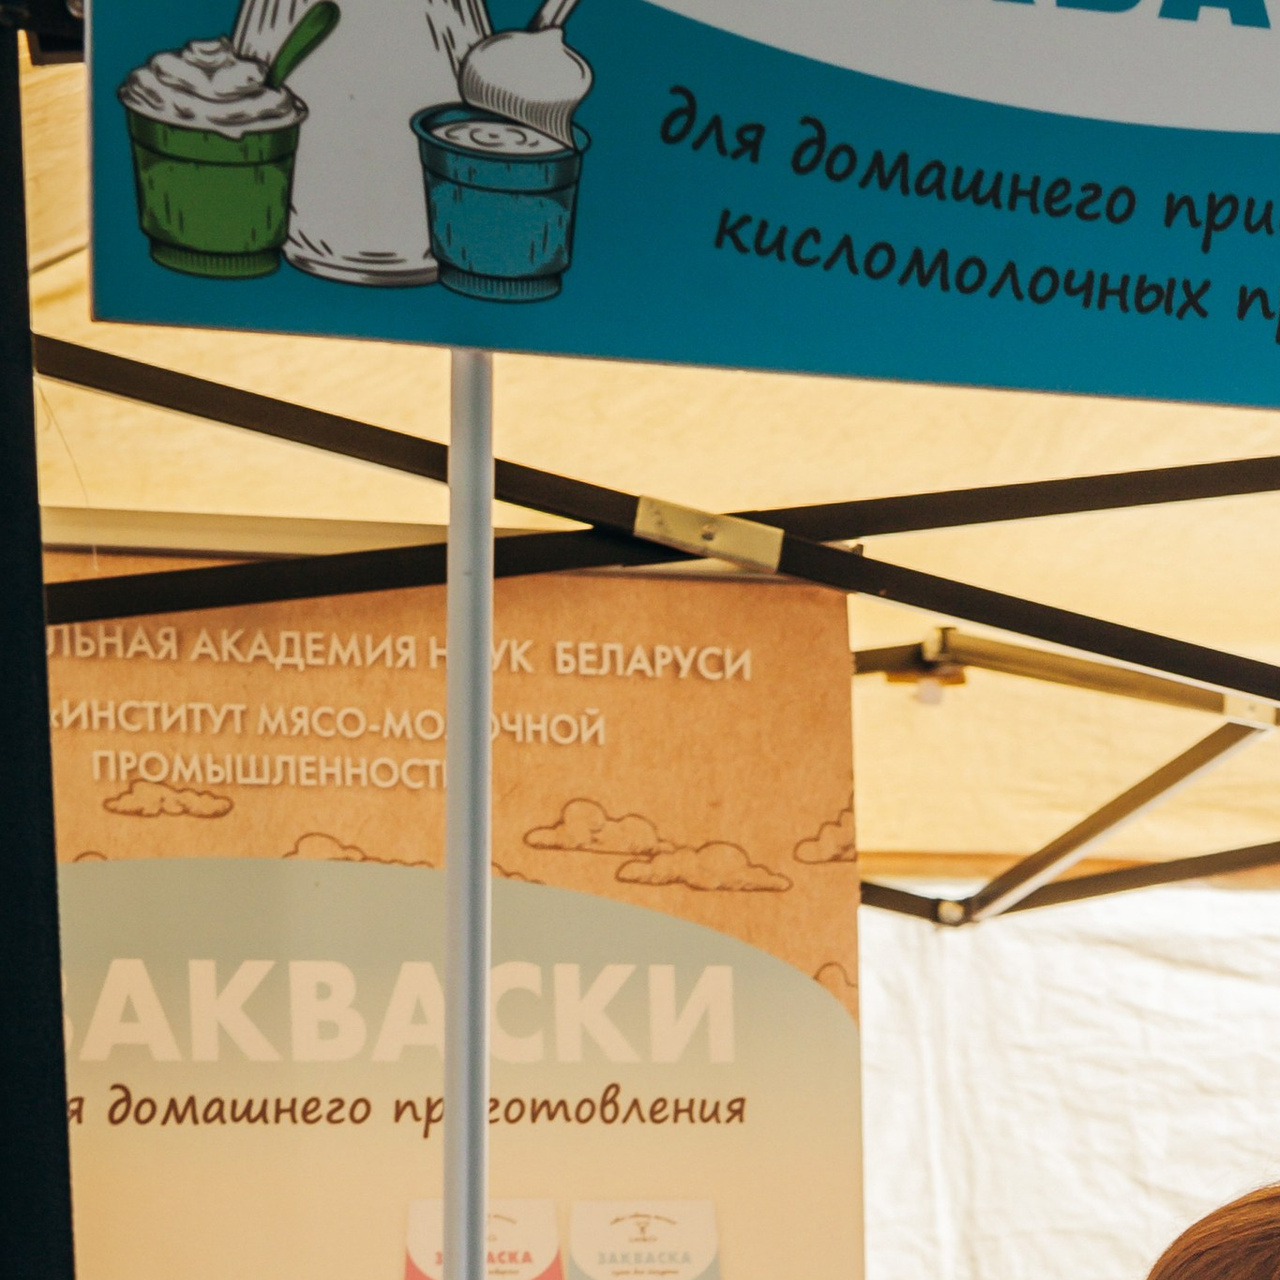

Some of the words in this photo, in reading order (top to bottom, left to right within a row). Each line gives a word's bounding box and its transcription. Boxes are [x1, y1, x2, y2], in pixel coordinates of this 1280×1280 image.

[658, 84, 764, 164] для
[791, 116, 1137, 226] домашнего
[713, 206, 1211, 321] кисломолочных
[190, 628, 417, 671] АКАДЕМИЯ
[428, 636, 534, 674] НУК
[555, 640, 752, 682] БЕЛАРУСИ
[257, 705, 606, 746] МЯСО-МОЧНОЙ
[92, 749, 446, 790] ПРОМЫШЛЕННОСТ
[62, 957, 736, 1066] АКВАСКИ
[107, 1082, 372, 1127] домашнего
[393, 1082, 747, 1139] прготовления
